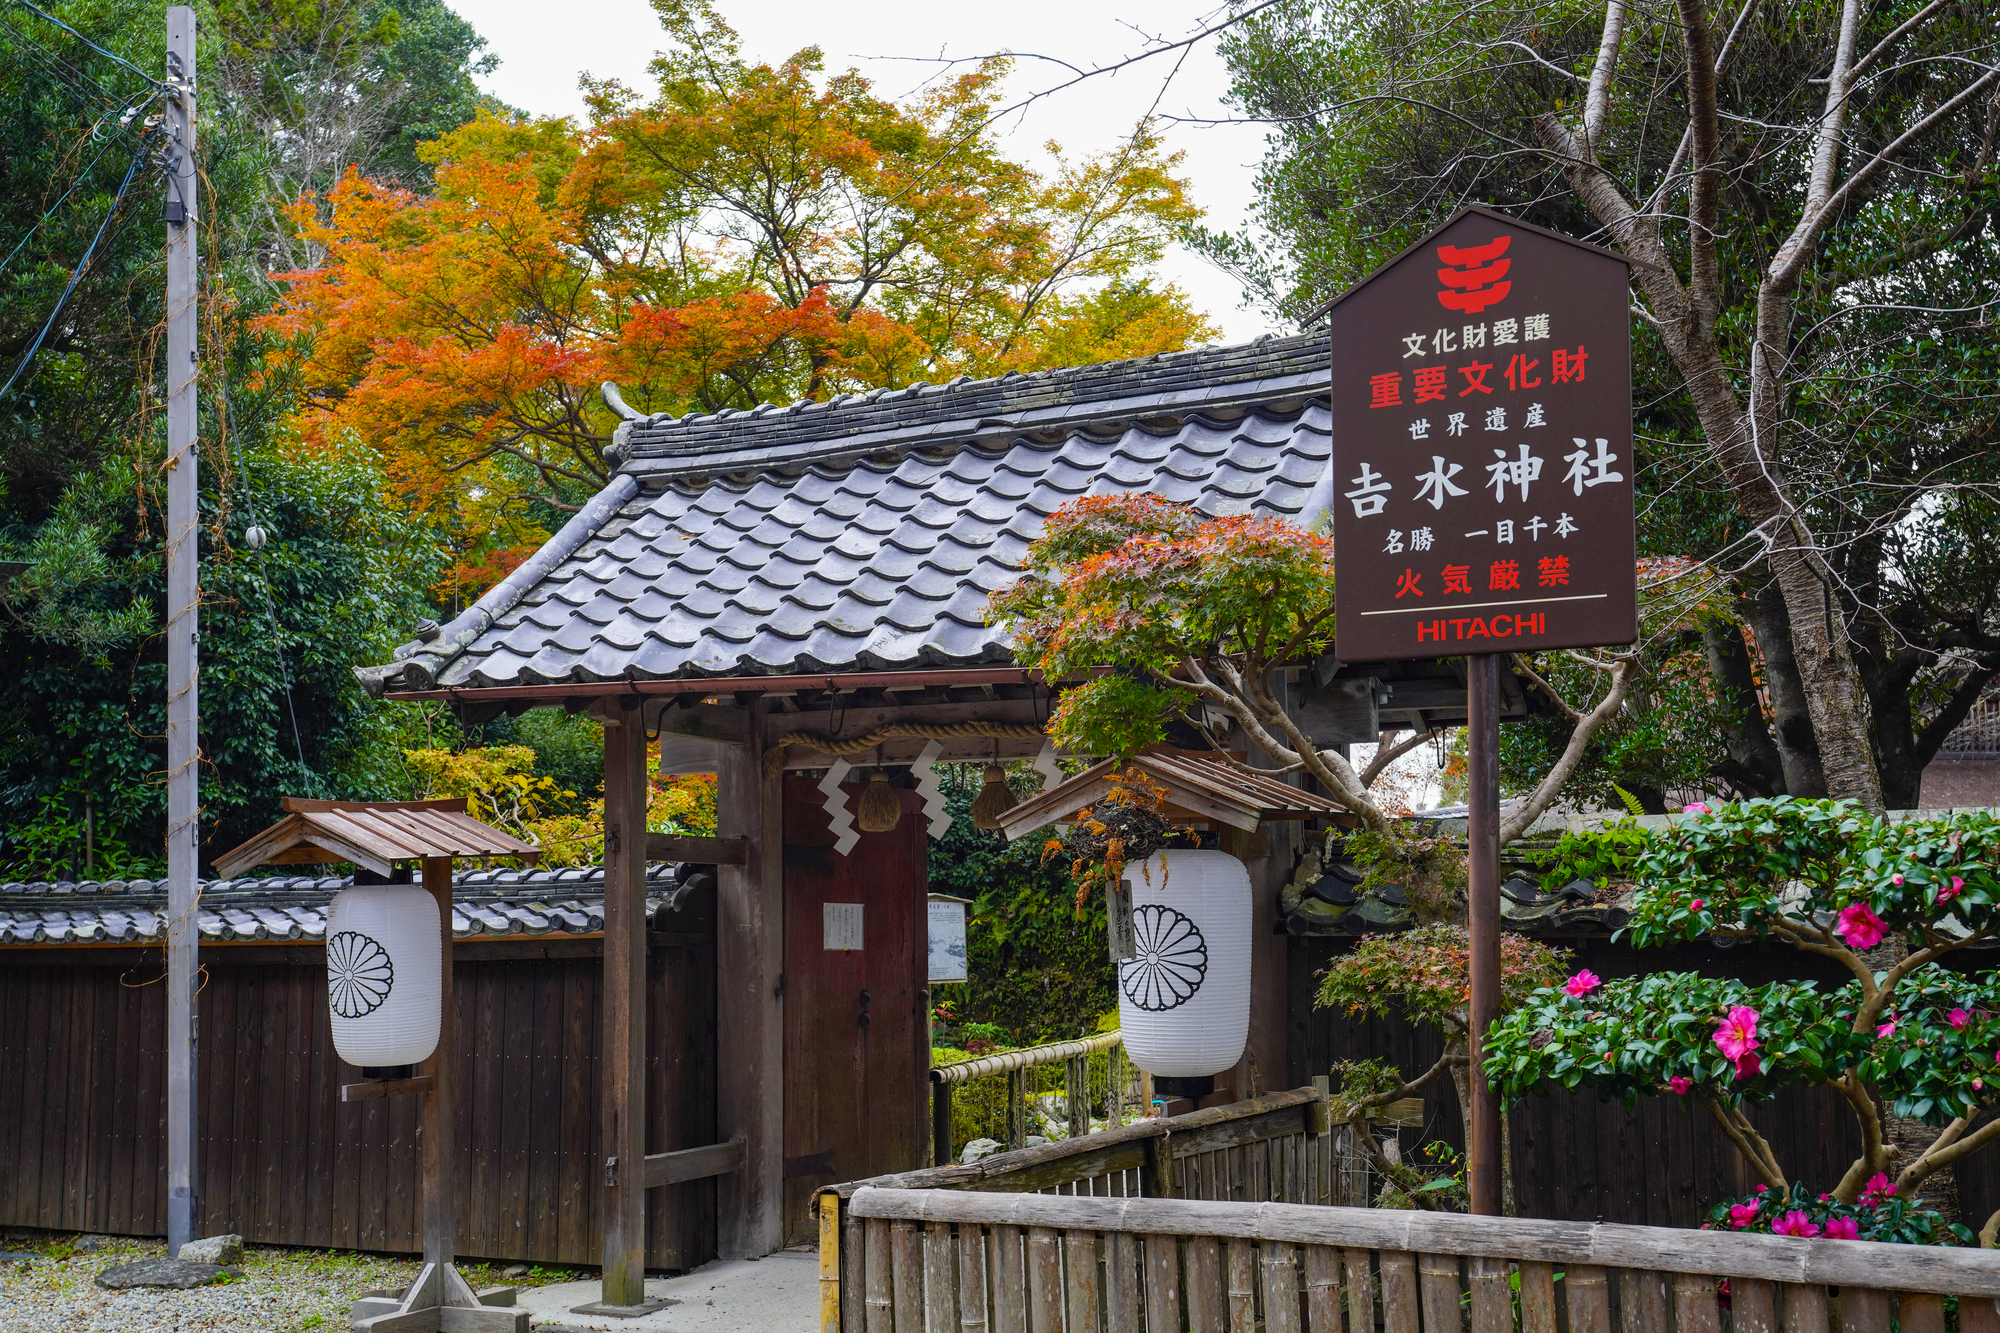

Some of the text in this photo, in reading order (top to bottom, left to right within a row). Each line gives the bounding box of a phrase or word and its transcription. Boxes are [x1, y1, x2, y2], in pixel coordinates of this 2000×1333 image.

[1402, 313, 1550, 358] 文化財愛護
[1369, 346, 1588, 408] 重要文化財
[1409, 403, 1546, 440] 世界遺産
[1382, 513, 1579, 555] 名勝 一目千本
[1395, 555, 1570, 598] 火気厳禁
[1417, 613, 1545, 642] HITACHI
